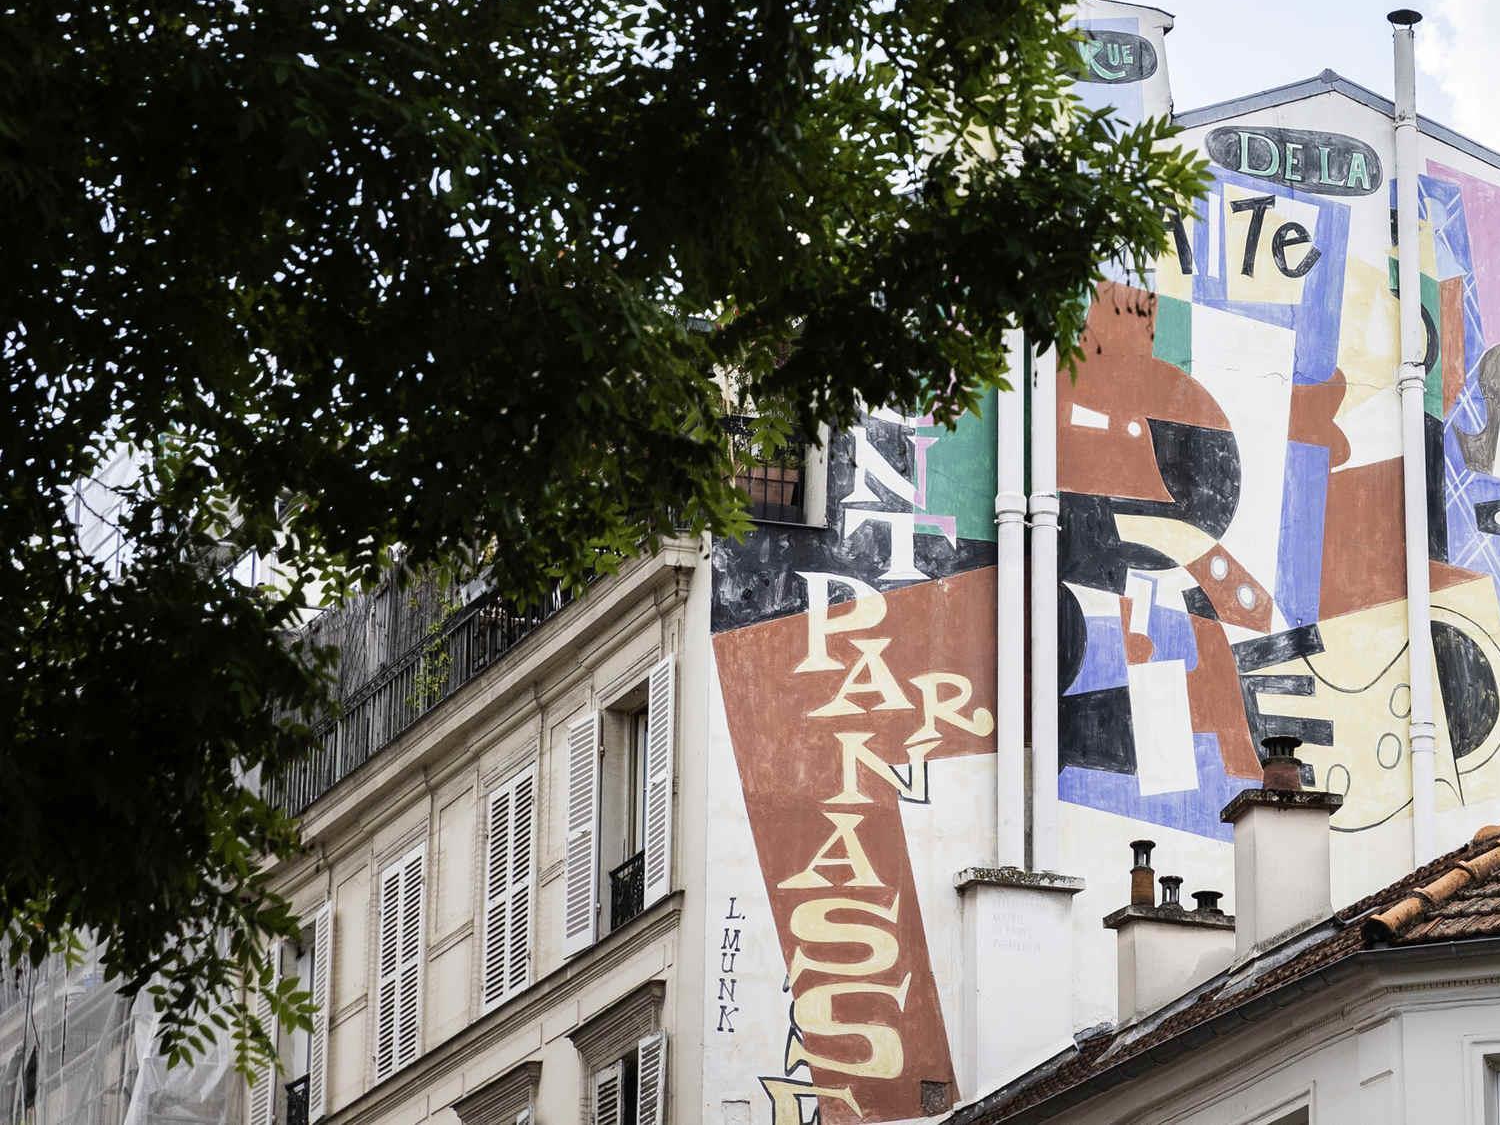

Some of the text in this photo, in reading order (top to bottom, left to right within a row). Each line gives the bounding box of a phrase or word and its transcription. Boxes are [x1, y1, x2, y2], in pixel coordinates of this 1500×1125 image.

[1077, 38, 1134, 81] RUE
[1237, 131, 1372, 191] DE LA
[716, 927, 742, 1033] MUNK
